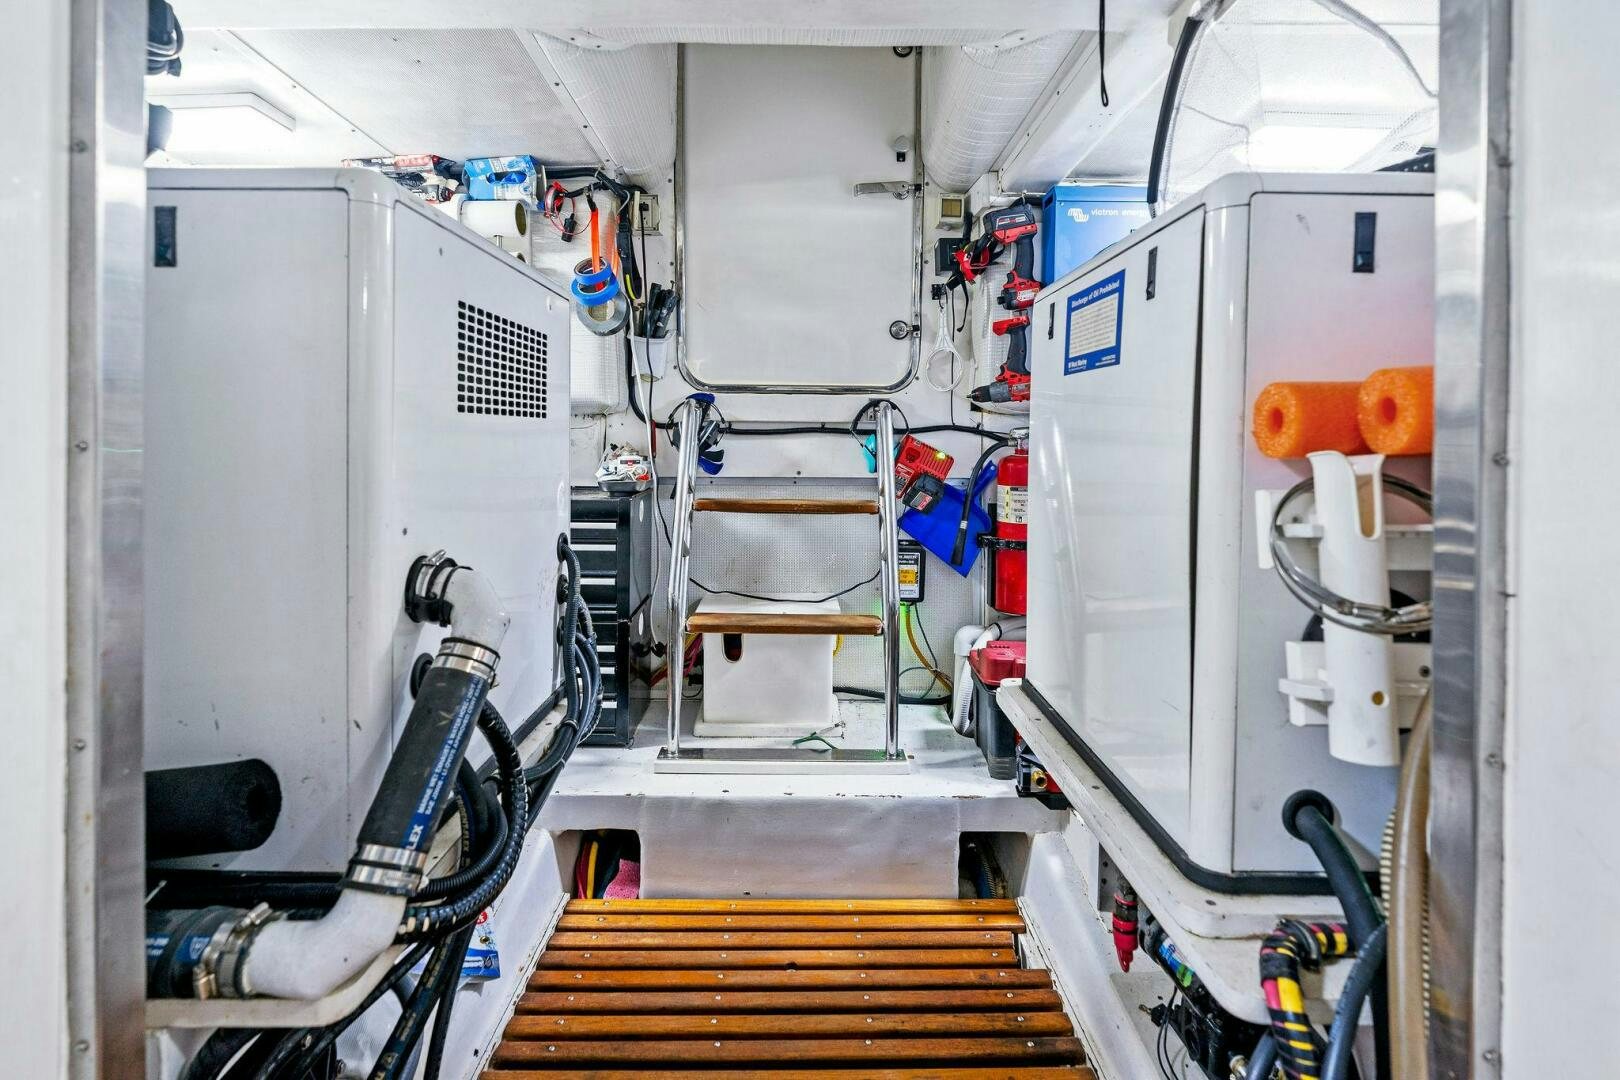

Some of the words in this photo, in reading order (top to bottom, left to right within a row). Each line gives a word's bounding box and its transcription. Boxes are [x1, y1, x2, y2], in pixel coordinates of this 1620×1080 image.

[1091, 208, 1119, 216] victron
[1071, 297, 1089, 309] Discharge
[1099, 280, 1120, 295] Prohibited
